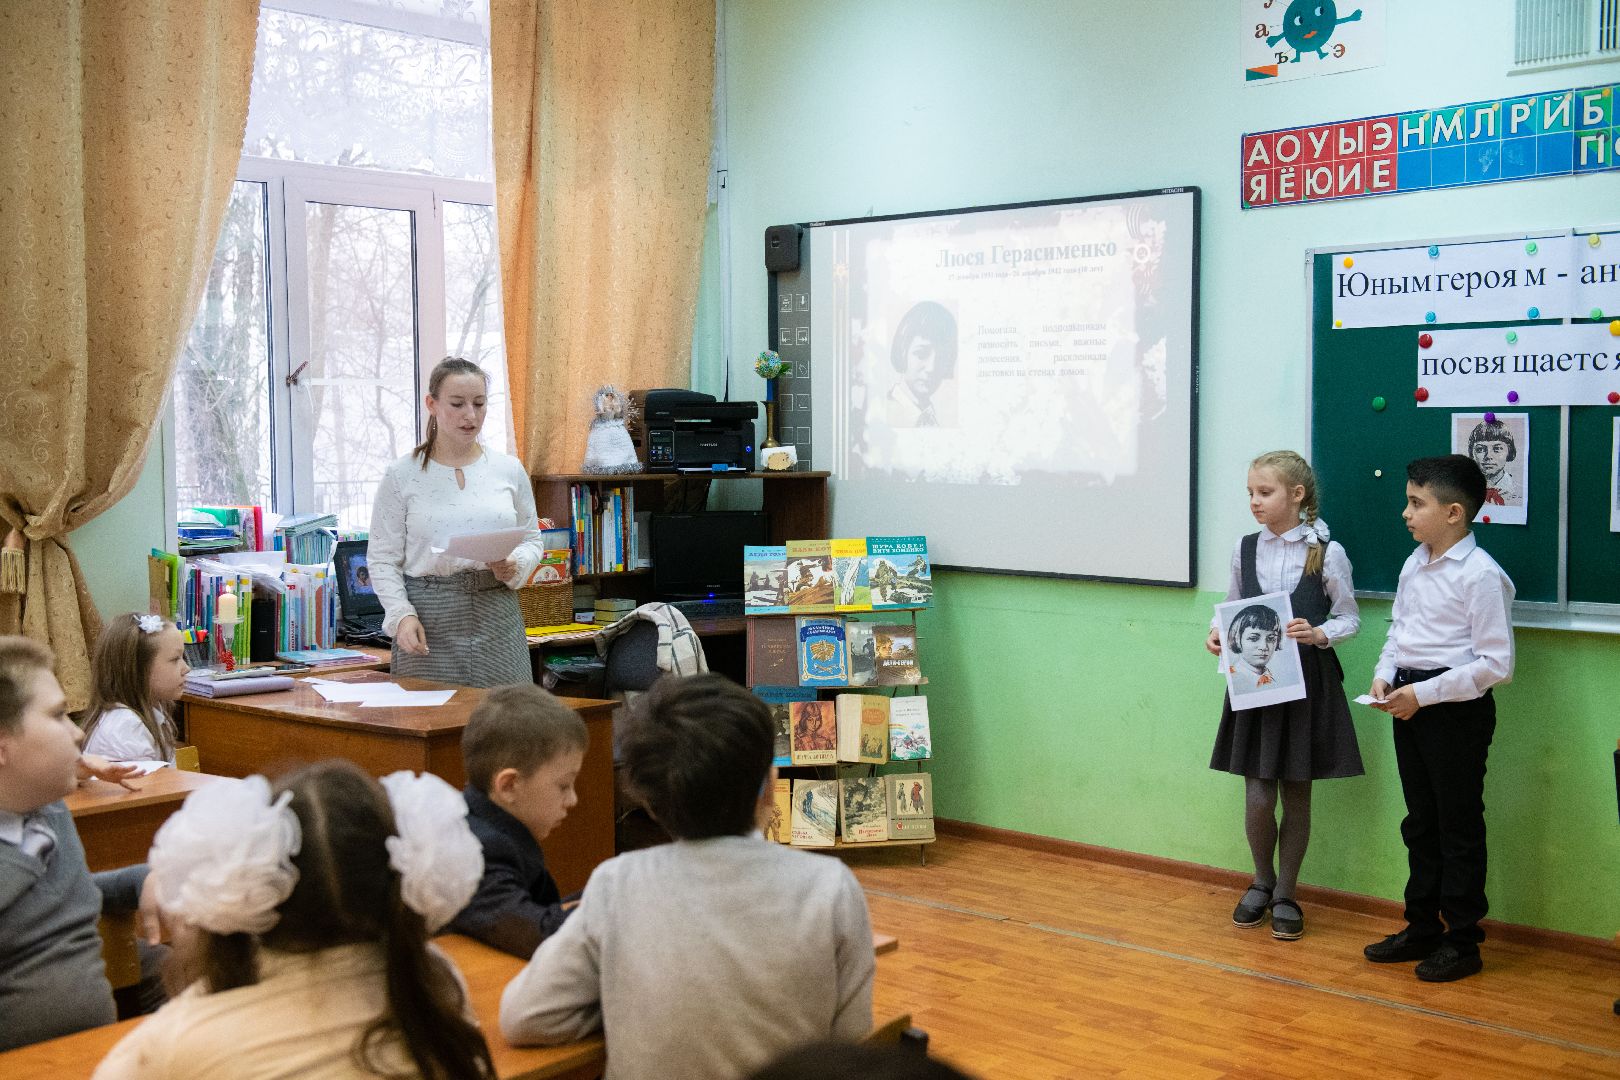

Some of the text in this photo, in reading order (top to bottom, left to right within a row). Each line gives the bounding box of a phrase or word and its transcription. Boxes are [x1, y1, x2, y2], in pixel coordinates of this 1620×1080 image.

[1255, 24, 1269, 38] а
[936, 241, 1117, 268] Люся Герасименко
[1581, 263, 1620, 285] ан
[978, 325, 1017, 336] Помогала
[1073, 338, 1107, 347] важные
[1028, 368, 1056, 377] стенах
[882, 659, 914, 667] ДЕТИ-ГЕРОИ
